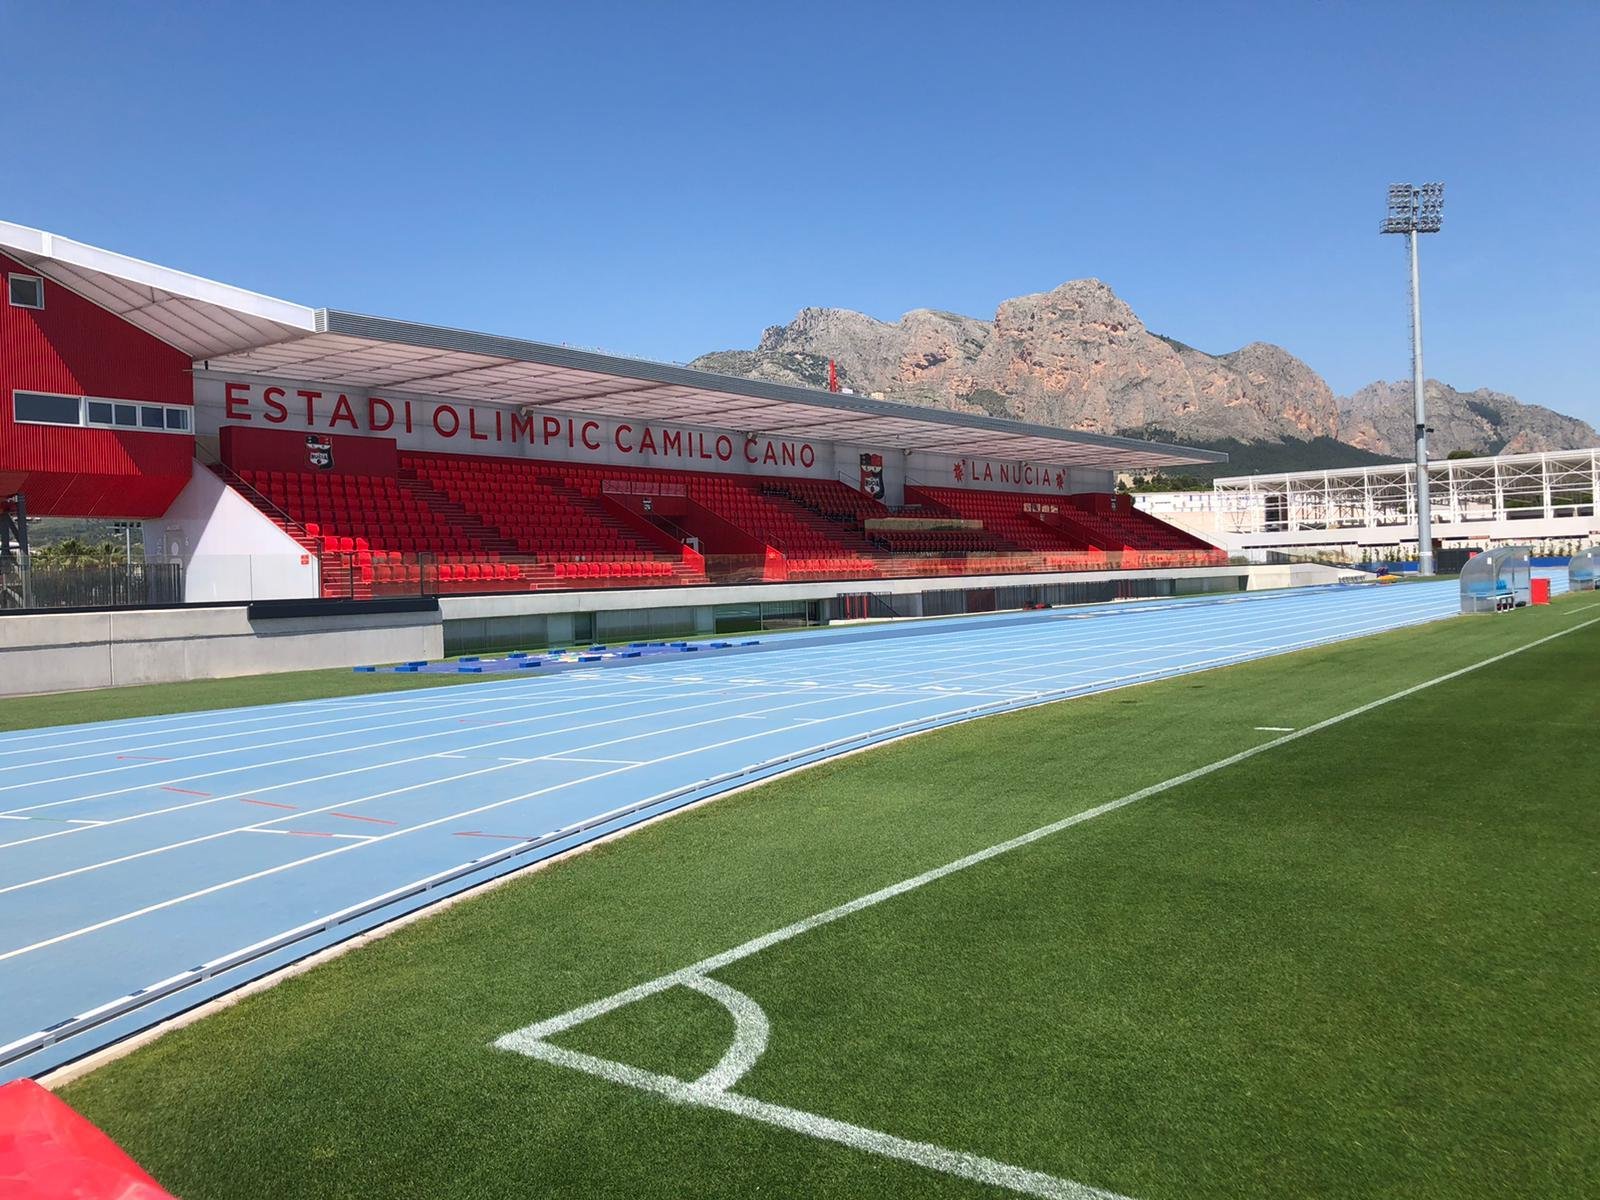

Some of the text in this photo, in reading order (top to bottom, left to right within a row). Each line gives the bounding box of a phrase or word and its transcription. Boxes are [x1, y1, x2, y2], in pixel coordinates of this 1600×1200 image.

[225, 382, 815, 468] ESTADI OLIMPIC CAMILO CANO
[972, 461, 993, 481] LA
